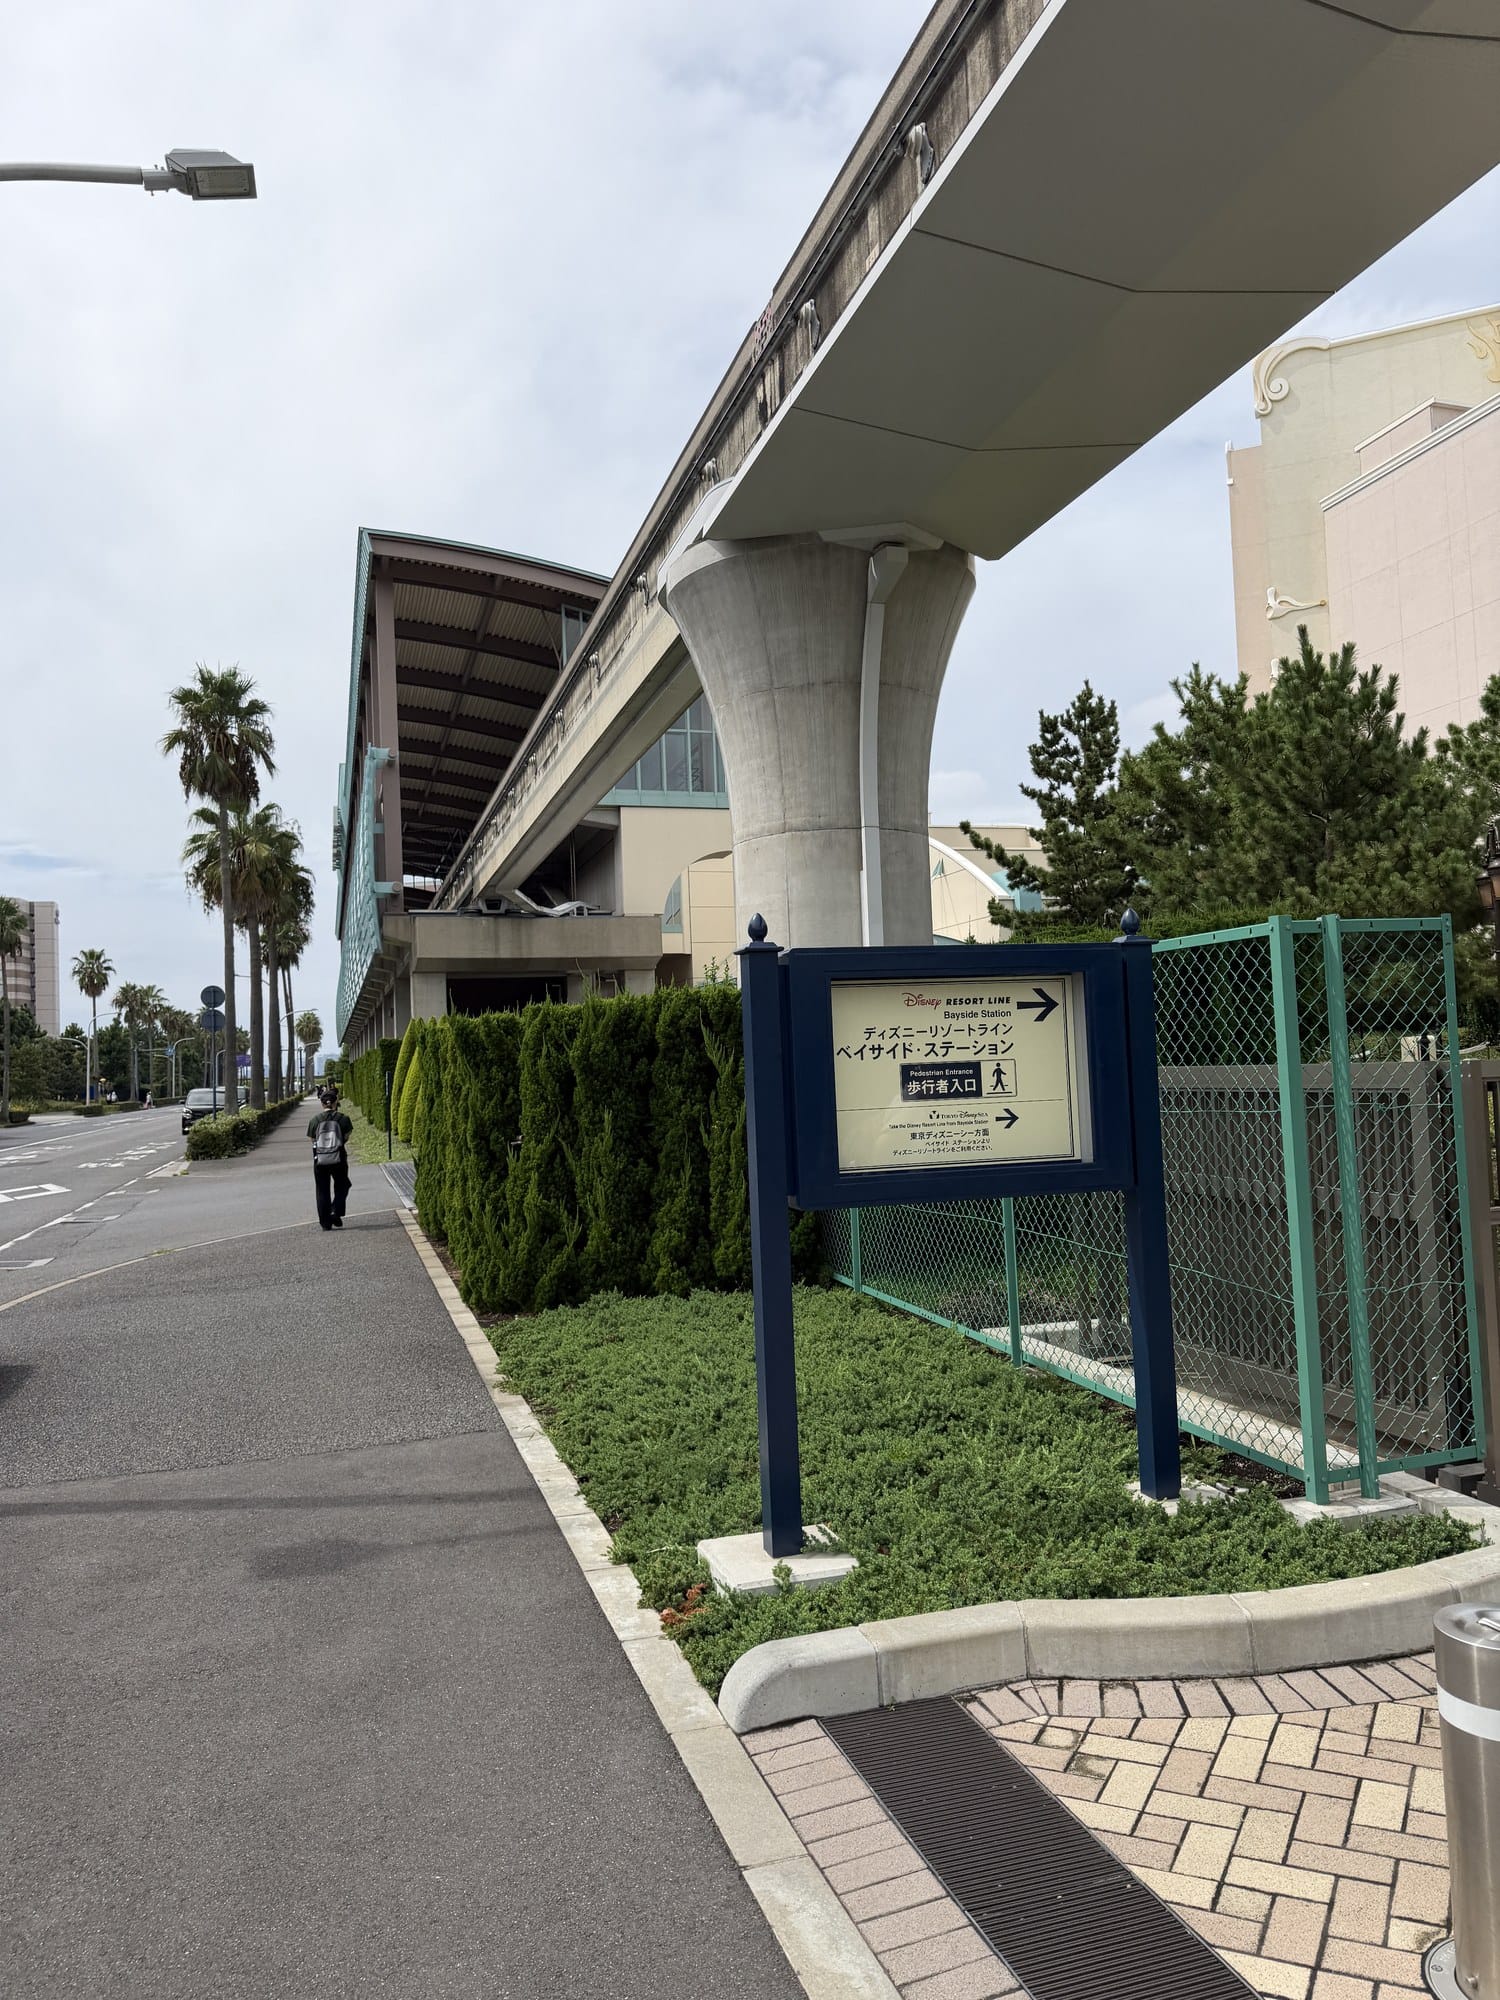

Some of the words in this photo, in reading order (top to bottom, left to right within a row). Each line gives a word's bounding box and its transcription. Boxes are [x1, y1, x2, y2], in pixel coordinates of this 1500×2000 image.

[902, 992, 942, 1010] Disney
[945, 997, 985, 1006] RESORT
[988, 996, 1011, 1005] LINE
[943, 1010, 979, 1020] Bayside
[980, 1009, 1012, 1018] Station
[863, 1023, 1013, 1041] ディズニーリゾートライン
[836, 1039, 1014, 1061] ベイサイド・ステーション
[909, 1069, 944, 1077] Pedestrian
[945, 1068, 974, 1076] Entrance
[907, 1078, 977, 1096] 歩行者入口
[910, 1128, 990, 1141] 東京ディズニーシー方面
